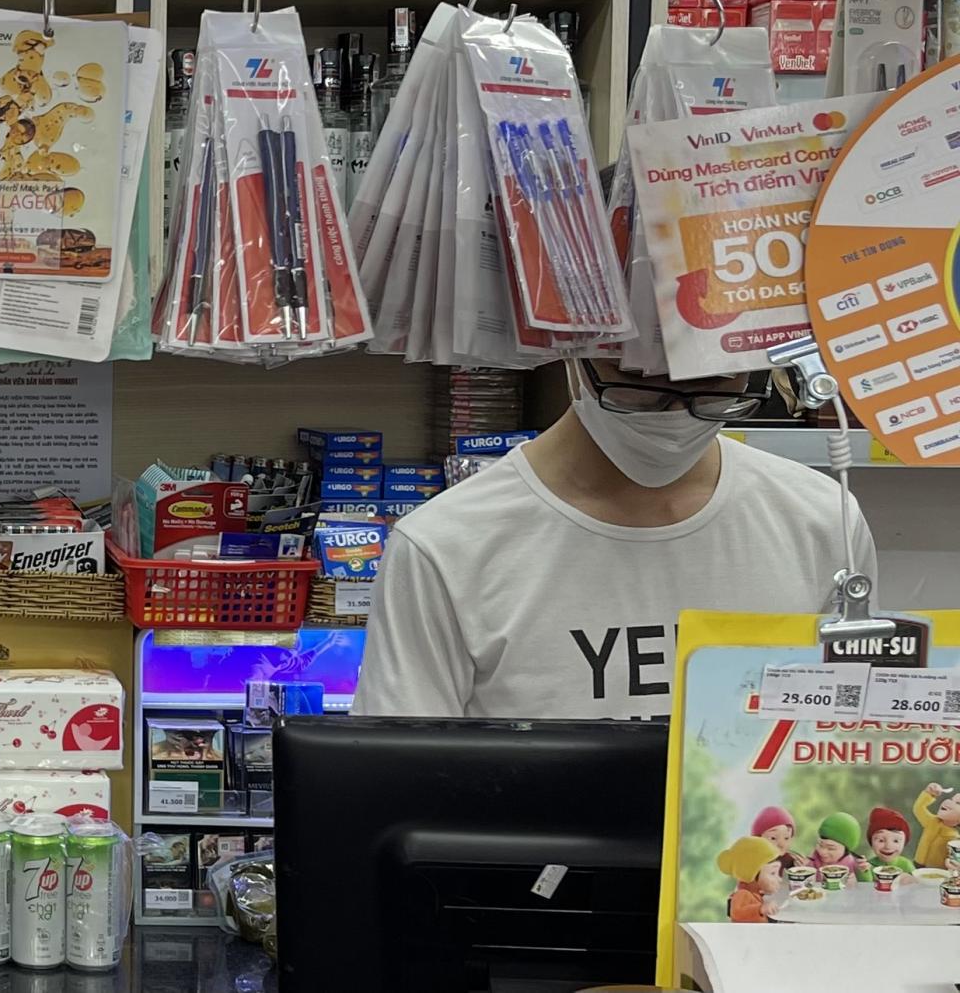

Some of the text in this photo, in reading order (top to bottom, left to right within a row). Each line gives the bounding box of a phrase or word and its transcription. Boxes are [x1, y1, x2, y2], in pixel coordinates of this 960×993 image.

[687, 121, 805, 150] VinID VinMart
[647, 164, 693, 185] Dùng
[695, 152, 792, 178] Mastercard
[694, 180, 740, 199] Tích
[743, 171, 797, 193] điểm
[876, 186, 903, 202] OCB
[723, 213, 781, 234] HOÀN
[896, 272, 933, 290] VPBank
[723, 287, 756, 303] TỐI
[758, 283, 787, 299] ĐA
[747, 331, 766, 345] TẢI
[765, 330, 787, 344] APP
[470, 436, 503, 448] URGO
[159, 483, 177, 492] 3M
[170, 503, 207, 515] Command
[263, 520, 301, 534] Scotch
[334, 532, 381, 546] URGO
[11, 541, 94, 571] Energizer
[832, 636, 917, 656] CHIN-SU
[569, 624, 677, 699] YE
[890, 699, 941, 712] 28.600
[793, 741, 872, 764] DINH
